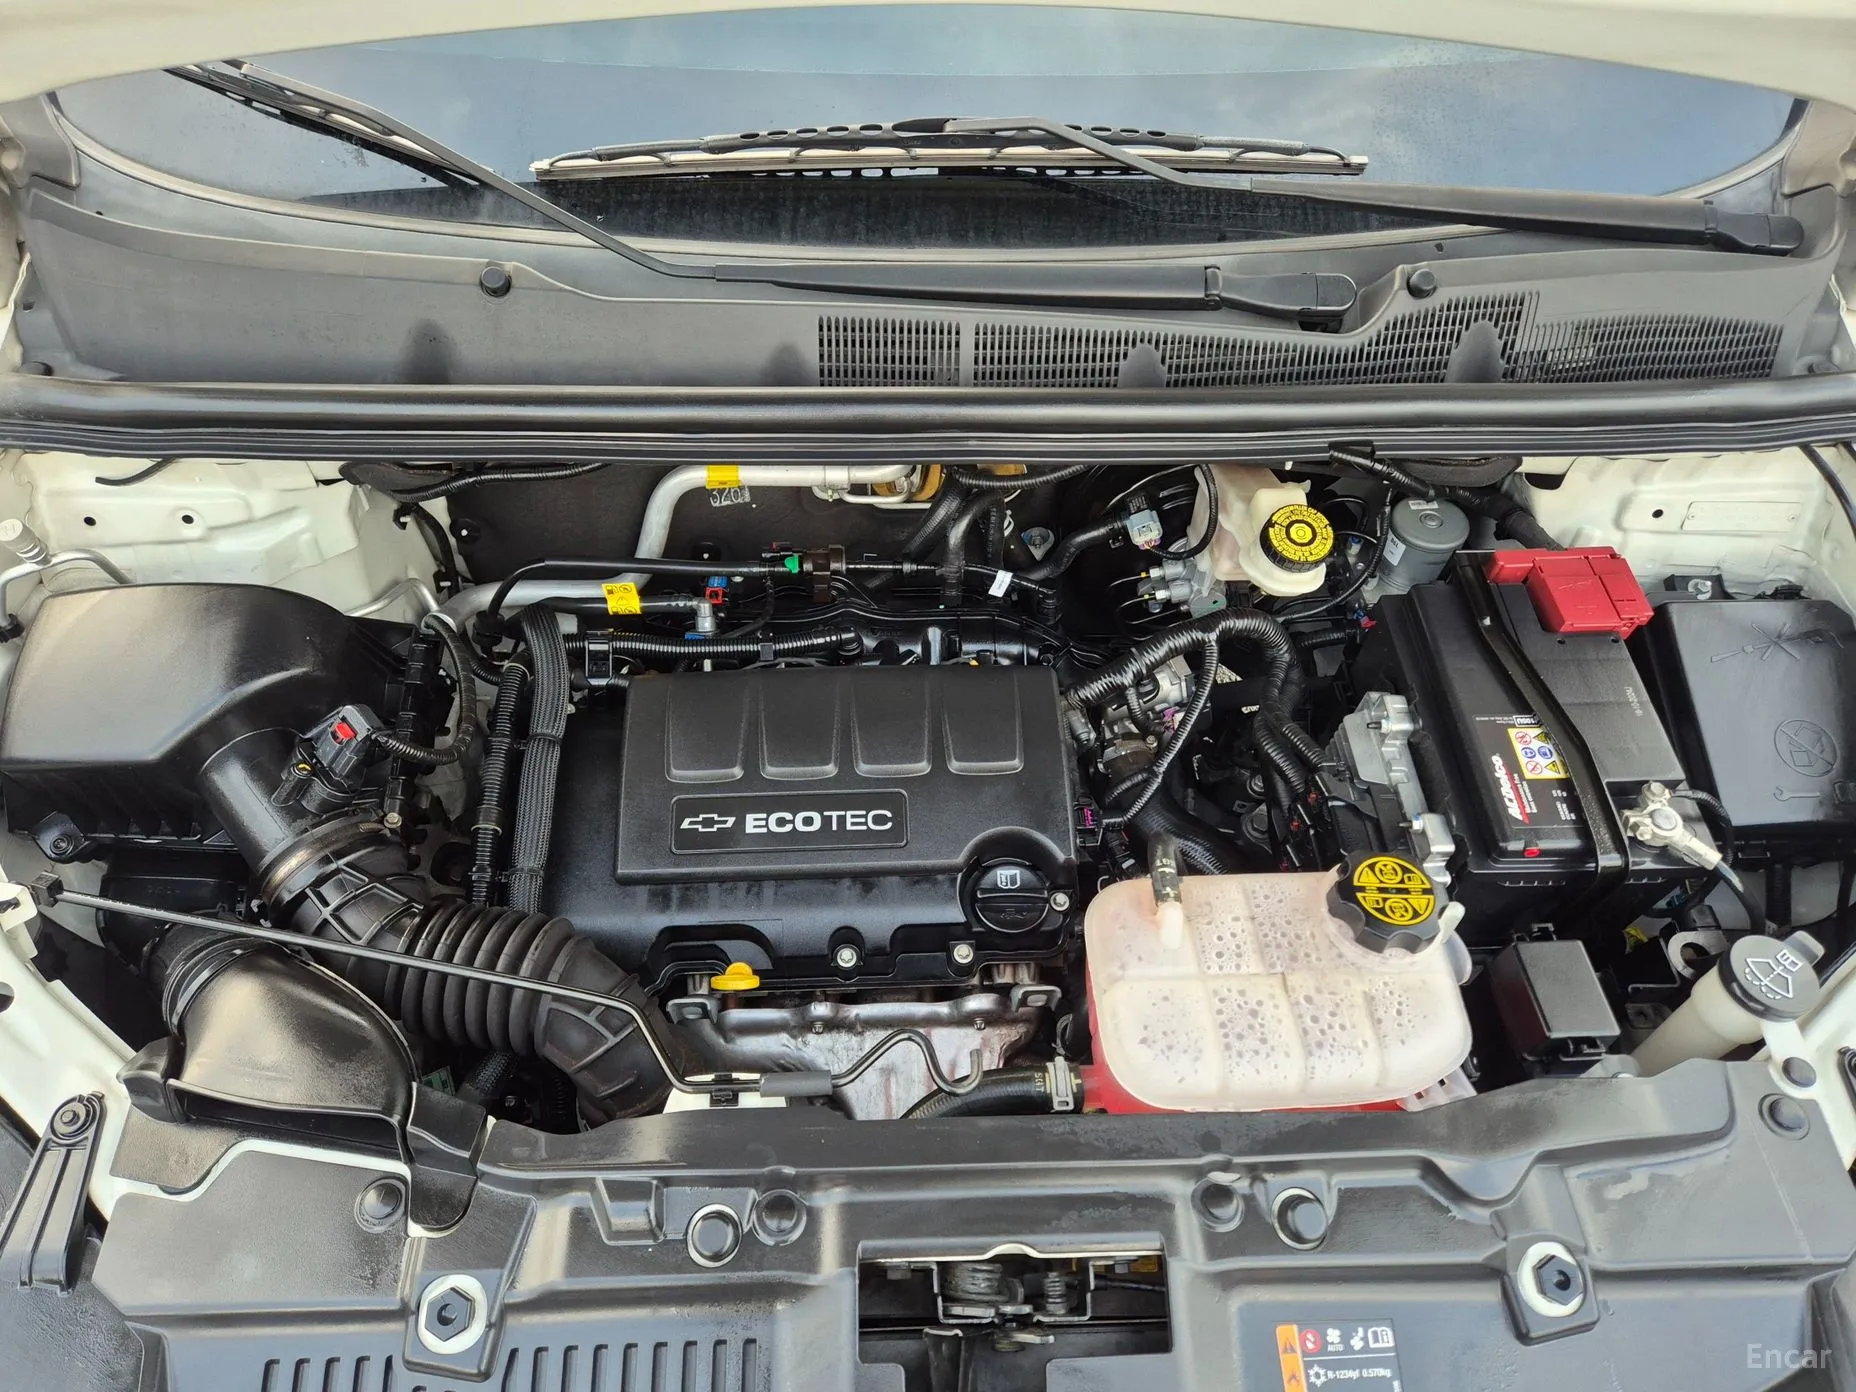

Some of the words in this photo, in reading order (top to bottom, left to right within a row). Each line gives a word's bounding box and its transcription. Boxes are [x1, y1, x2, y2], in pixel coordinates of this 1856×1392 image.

[1491, 754, 1523, 821] ACDelco
[745, 809, 893, 834] ECOTEC
[1327, 1344, 1344, 1352] AUTO
[1327, 1368, 1360, 1380] R-1234yf
